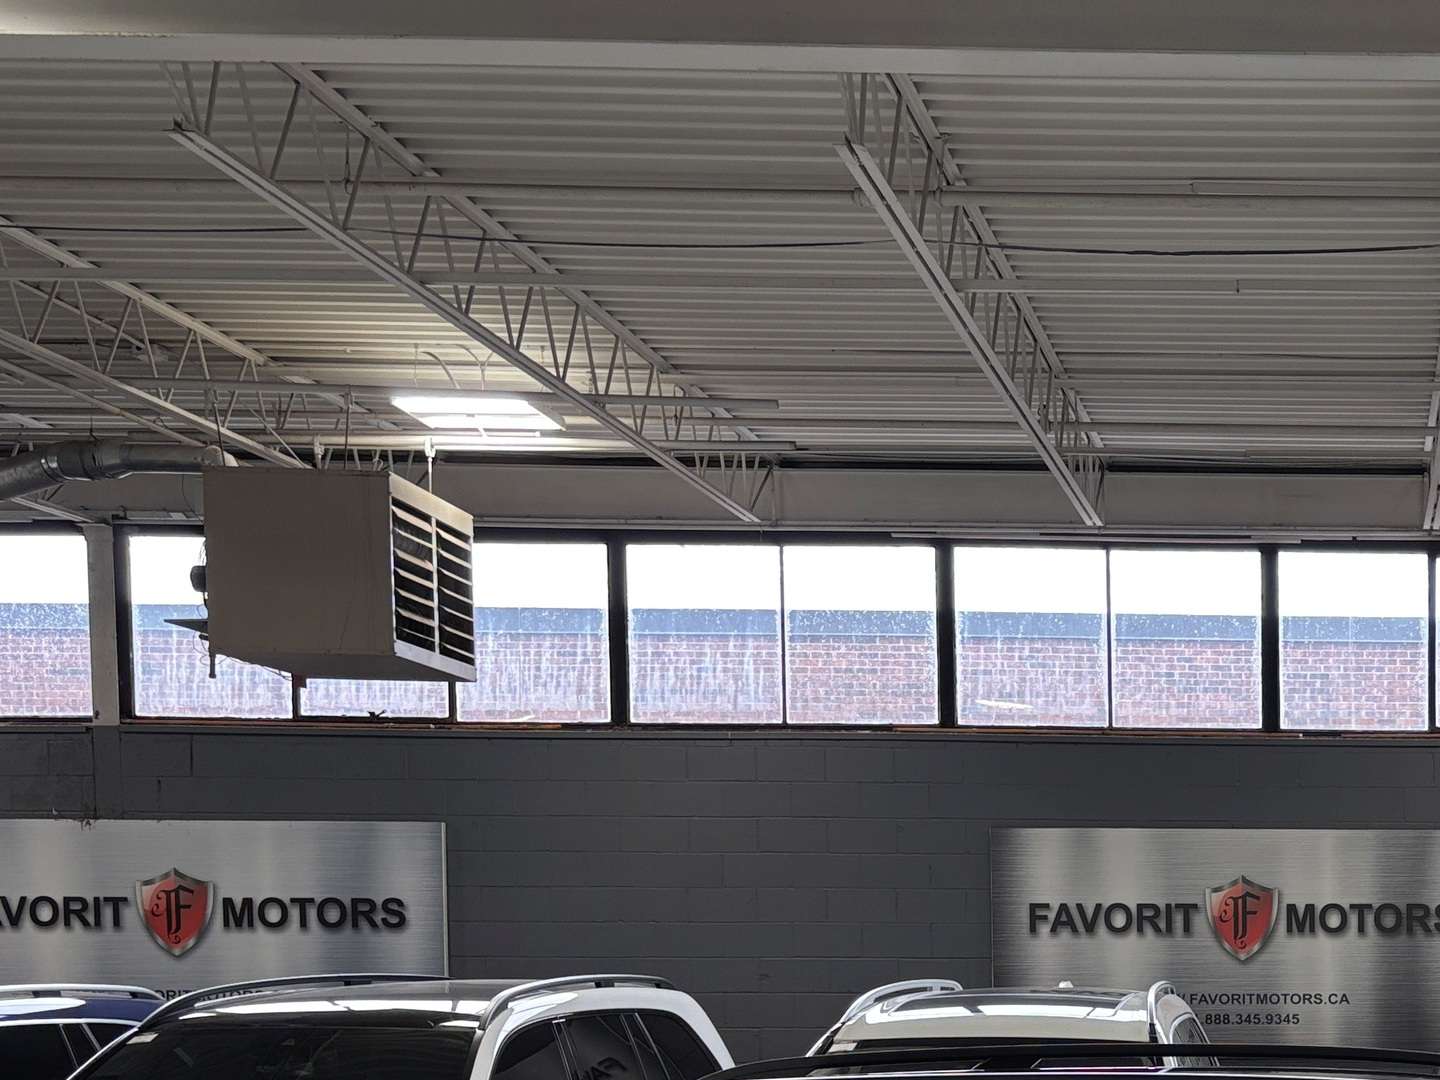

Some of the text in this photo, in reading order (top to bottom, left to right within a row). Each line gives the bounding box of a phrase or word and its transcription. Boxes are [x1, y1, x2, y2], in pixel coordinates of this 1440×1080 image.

[0, 895, 129, 928] VORIT
[222, 896, 407, 929] MOTORS
[1028, 902, 1198, 934] FAVORIT
